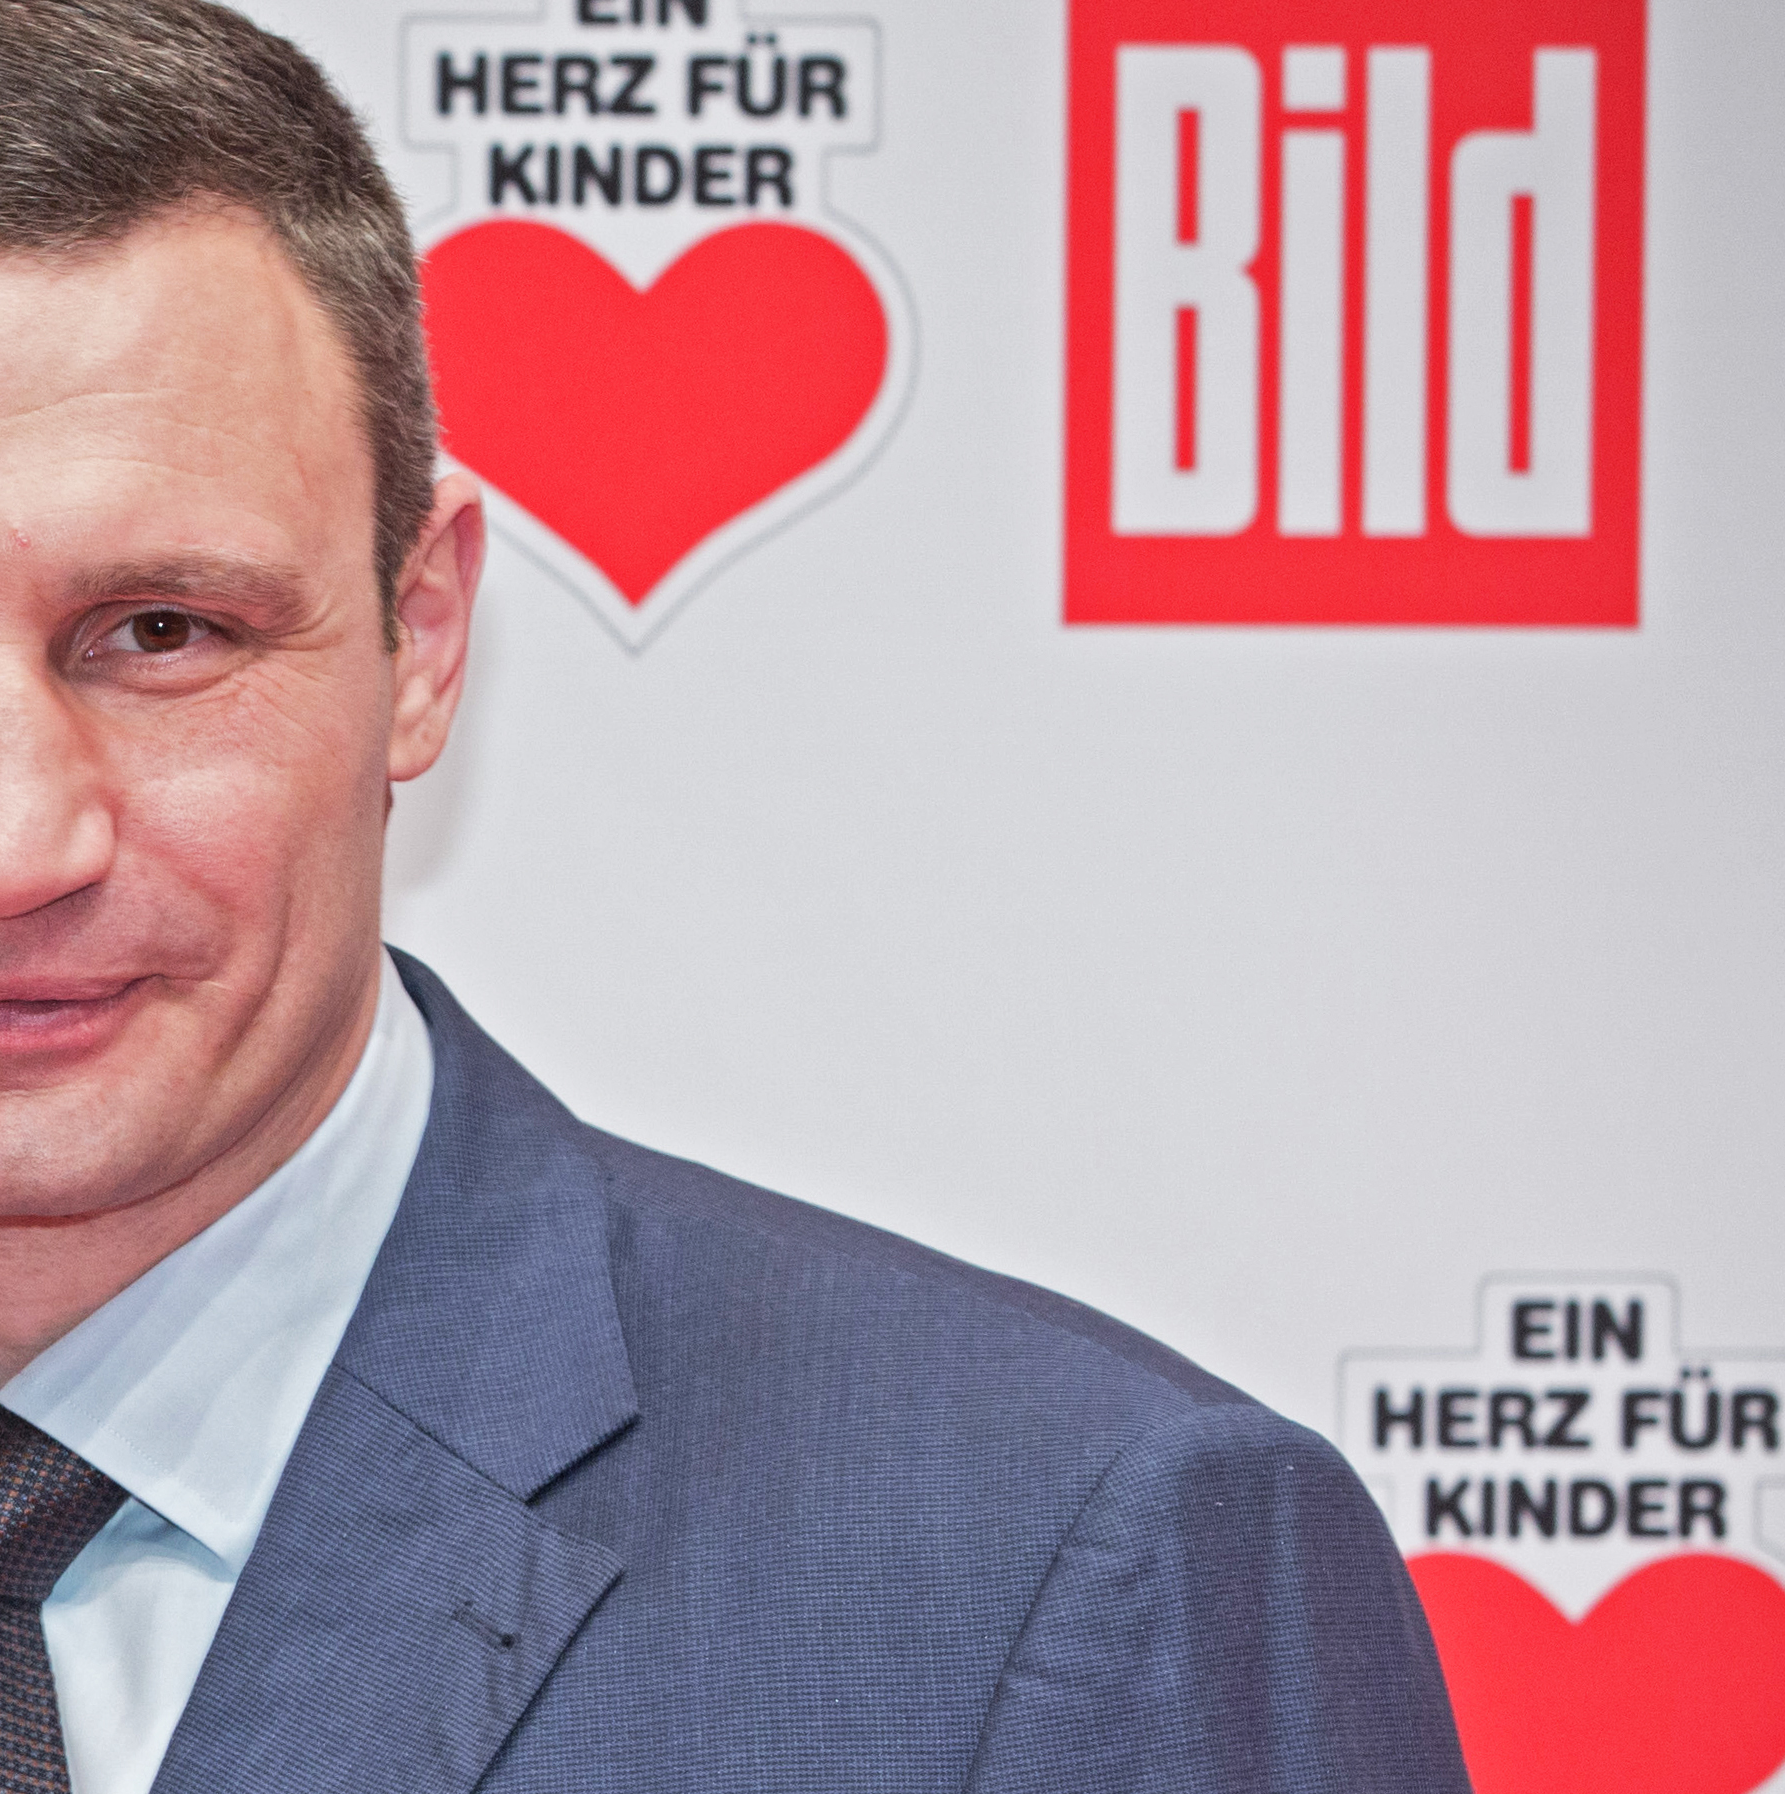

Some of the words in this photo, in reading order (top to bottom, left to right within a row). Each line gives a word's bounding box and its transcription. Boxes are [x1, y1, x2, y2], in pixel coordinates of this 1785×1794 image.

[436, 52, 658, 117] HERZ
[687, 34, 847, 120] FÜR
[488, 144, 795, 209] KINDER
[1111, 44, 1598, 538] Bild
[1511, 1299, 1645, 1362] EIN
[1372, 1387, 1592, 1451] HERZ
[1621, 1367, 1781, 1452] FÜR
[1424, 1478, 1728, 1541] KINDER
